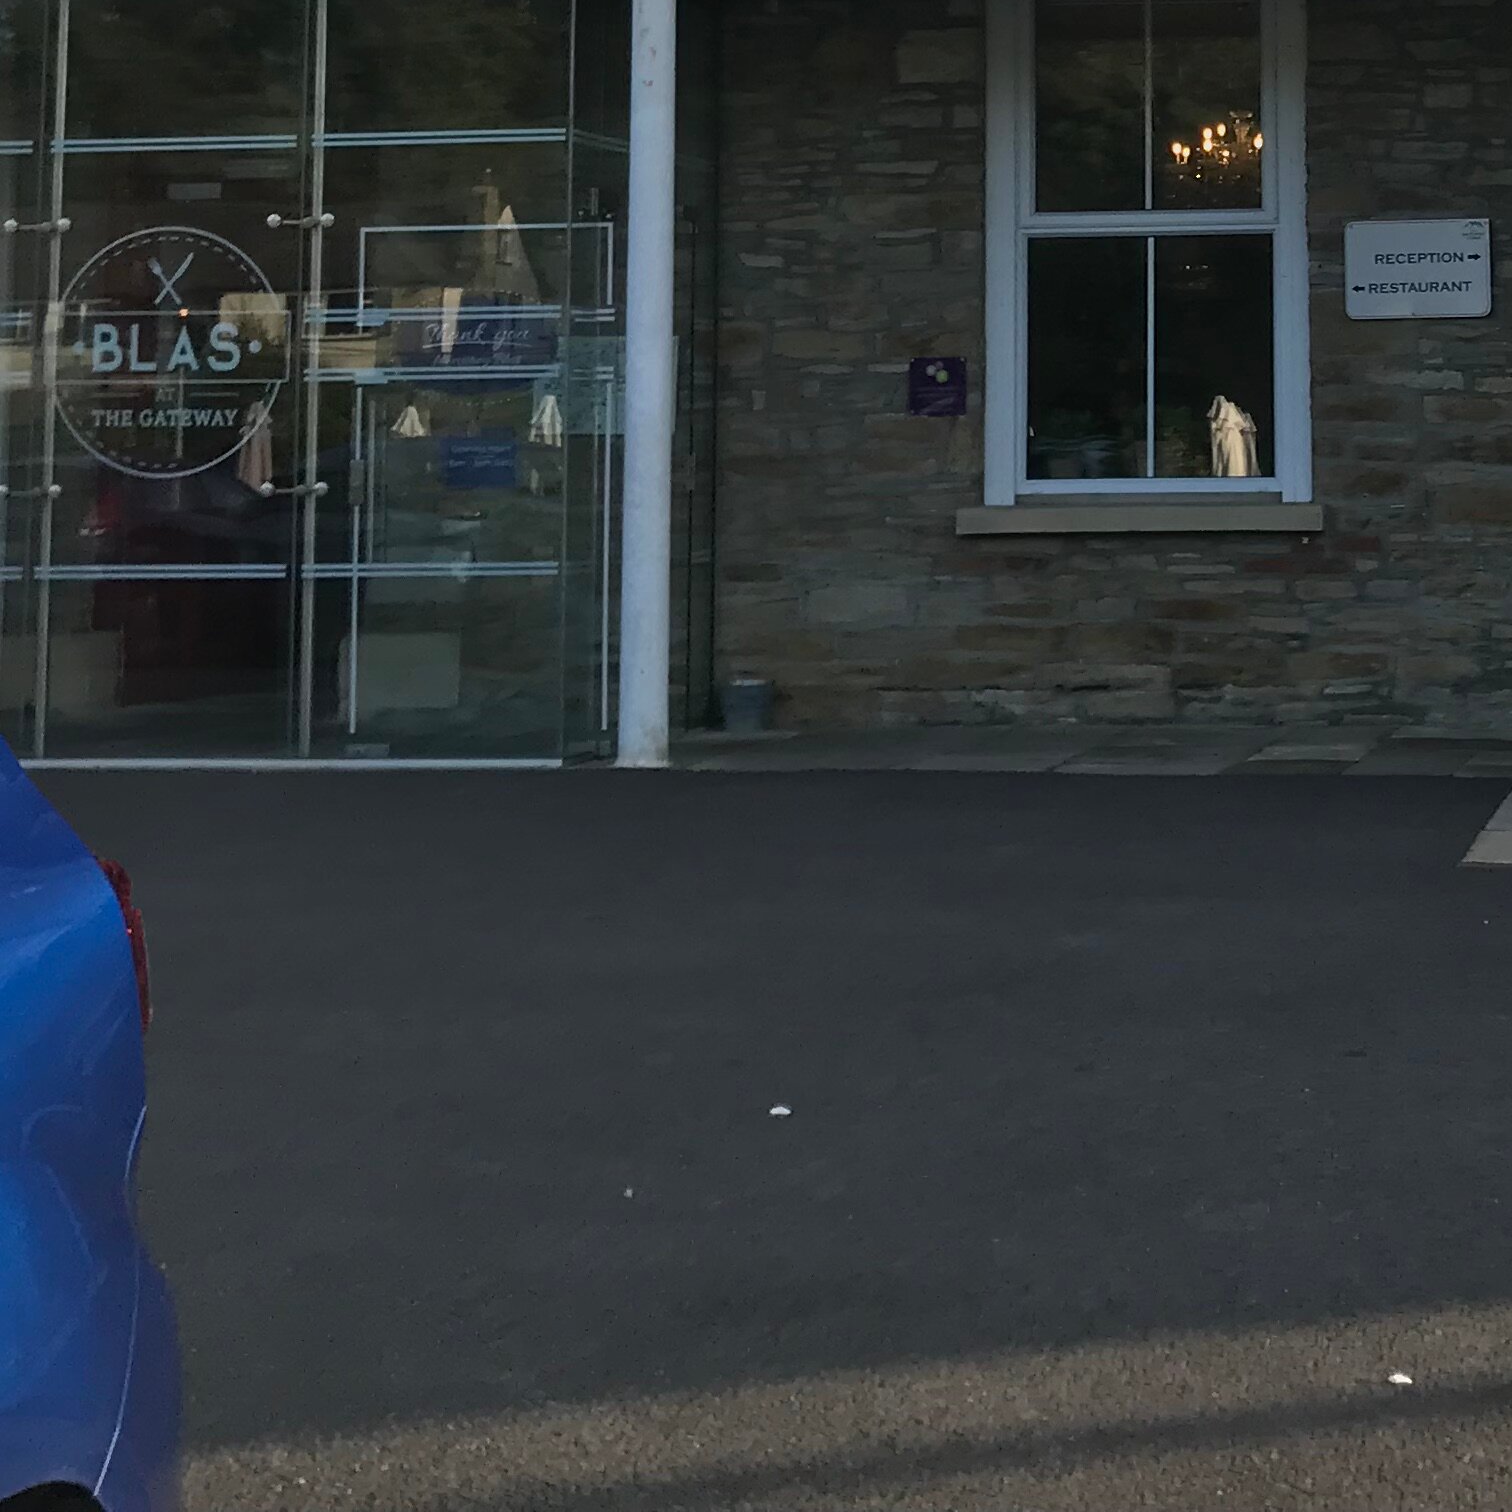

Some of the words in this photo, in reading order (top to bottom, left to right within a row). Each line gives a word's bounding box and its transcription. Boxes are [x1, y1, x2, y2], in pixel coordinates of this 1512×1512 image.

[1375, 252, 1464, 265] RECEPTION
[1369, 281, 1472, 294] RESTAURANT
[92, 323, 241, 372] BLAS
[156, 389, 176, 402] AT
[91, 409, 133, 427] THE
[139, 409, 238, 427] GATEWAY
